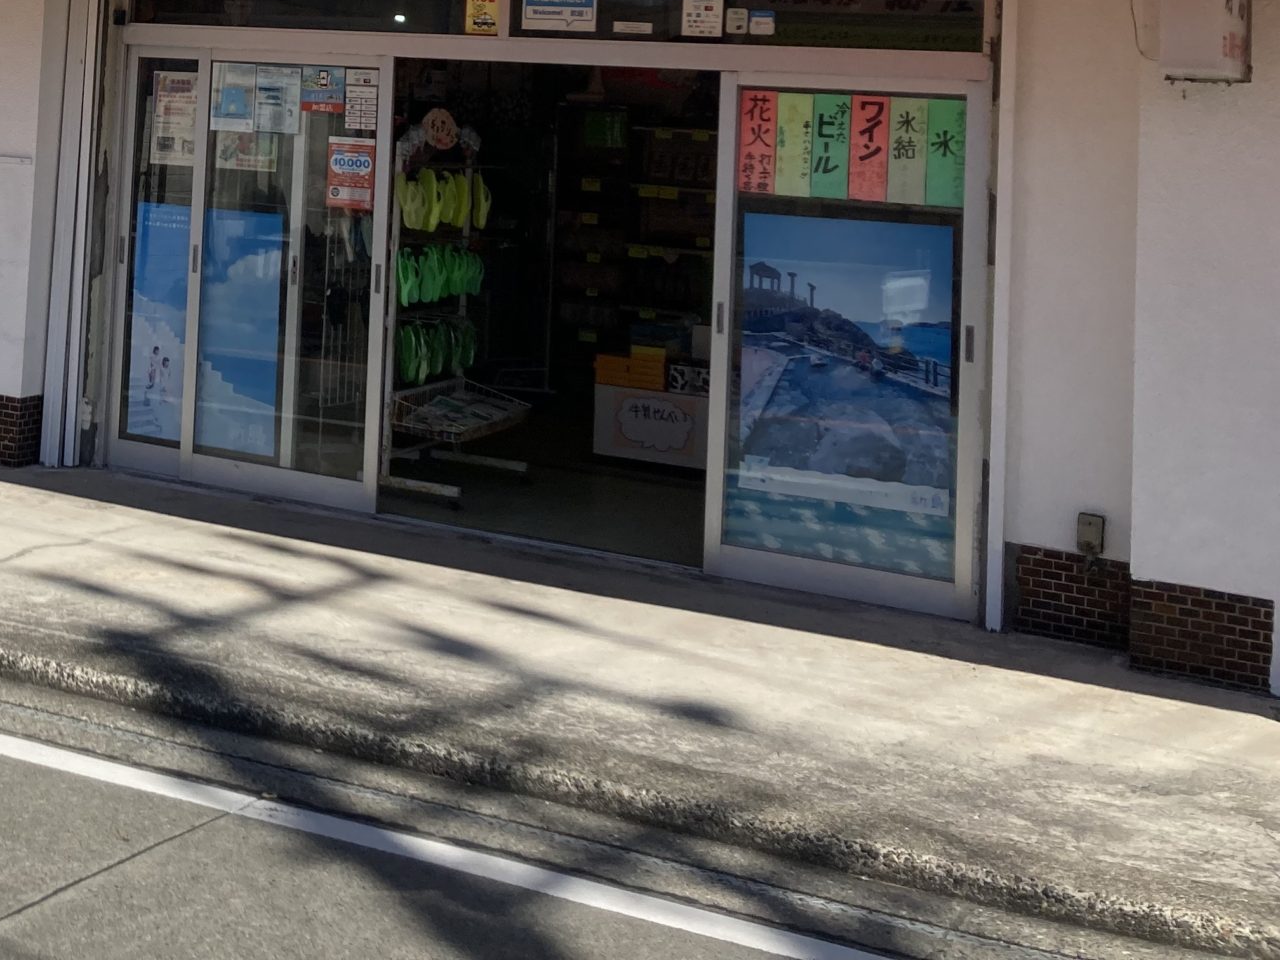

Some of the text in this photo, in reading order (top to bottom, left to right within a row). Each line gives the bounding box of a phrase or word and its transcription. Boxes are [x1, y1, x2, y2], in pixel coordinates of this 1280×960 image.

[743, 95, 772, 148] 花火
[813, 113, 840, 175] ビール
[834, 101, 851, 144] 冷えた
[858, 100, 885, 162] ワイン
[892, 111, 919, 160] 氷結
[930, 129, 958, 158] 氷
